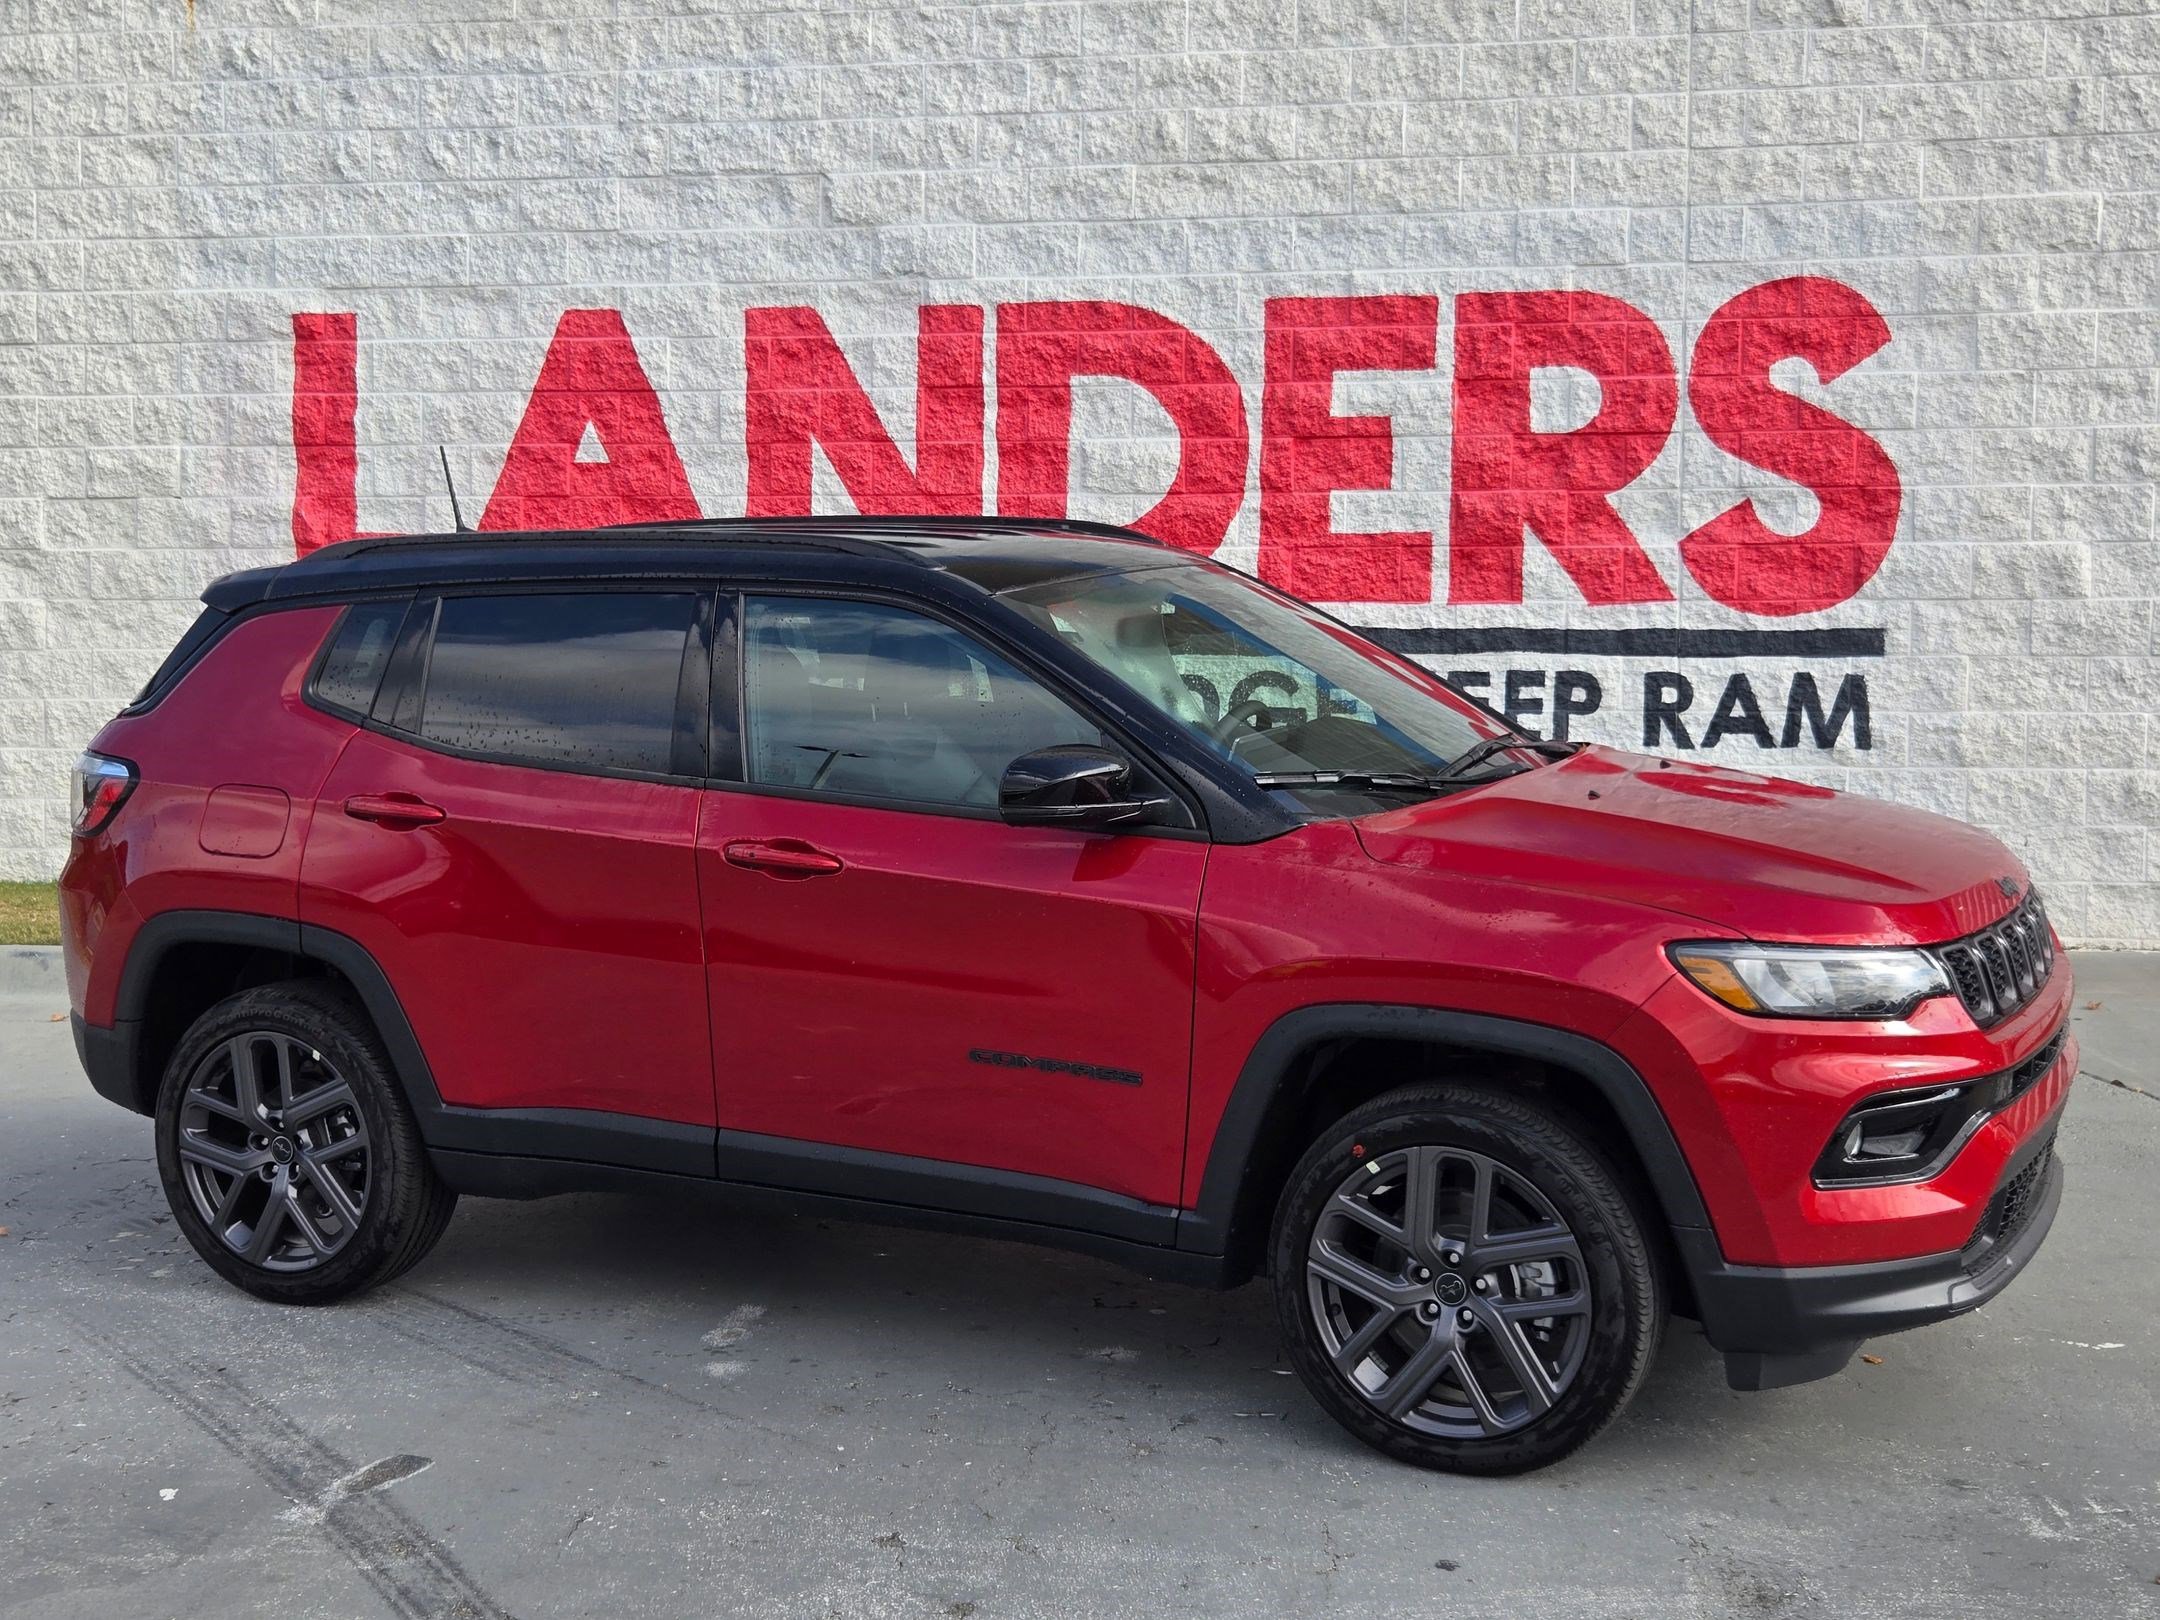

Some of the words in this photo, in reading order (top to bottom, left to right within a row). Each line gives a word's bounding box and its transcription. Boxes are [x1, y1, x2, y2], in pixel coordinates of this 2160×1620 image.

[291, 275, 1902, 617] LANDERS
[1446, 669, 1603, 741] EP
[1643, 671, 1873, 751] RAM
[968, 1047, 1144, 1087] COMPASS
